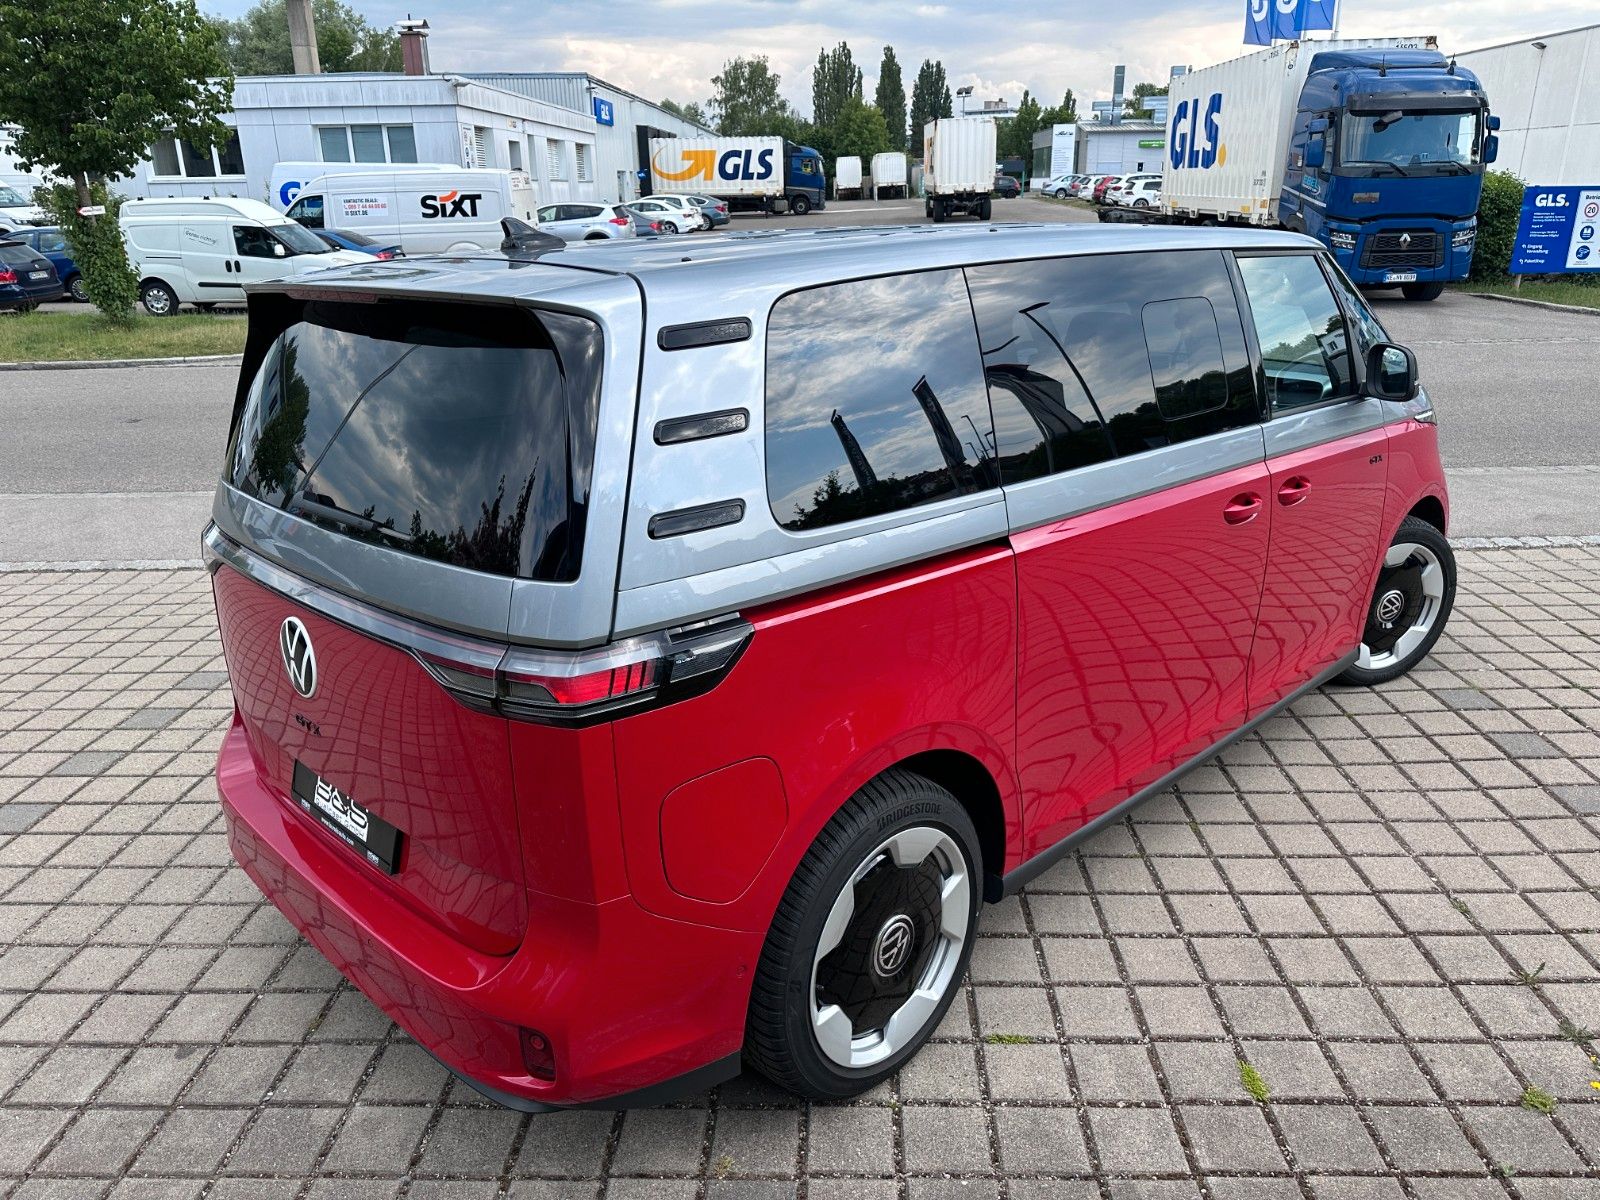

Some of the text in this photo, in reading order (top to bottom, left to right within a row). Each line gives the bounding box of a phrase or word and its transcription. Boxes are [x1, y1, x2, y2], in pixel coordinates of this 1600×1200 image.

[718, 149, 774, 181] GLS
[420, 189, 482, 218] SIXT
[1586, 206, 1596, 214] 20
[877, 802, 943, 832] BRIDGESTONE
